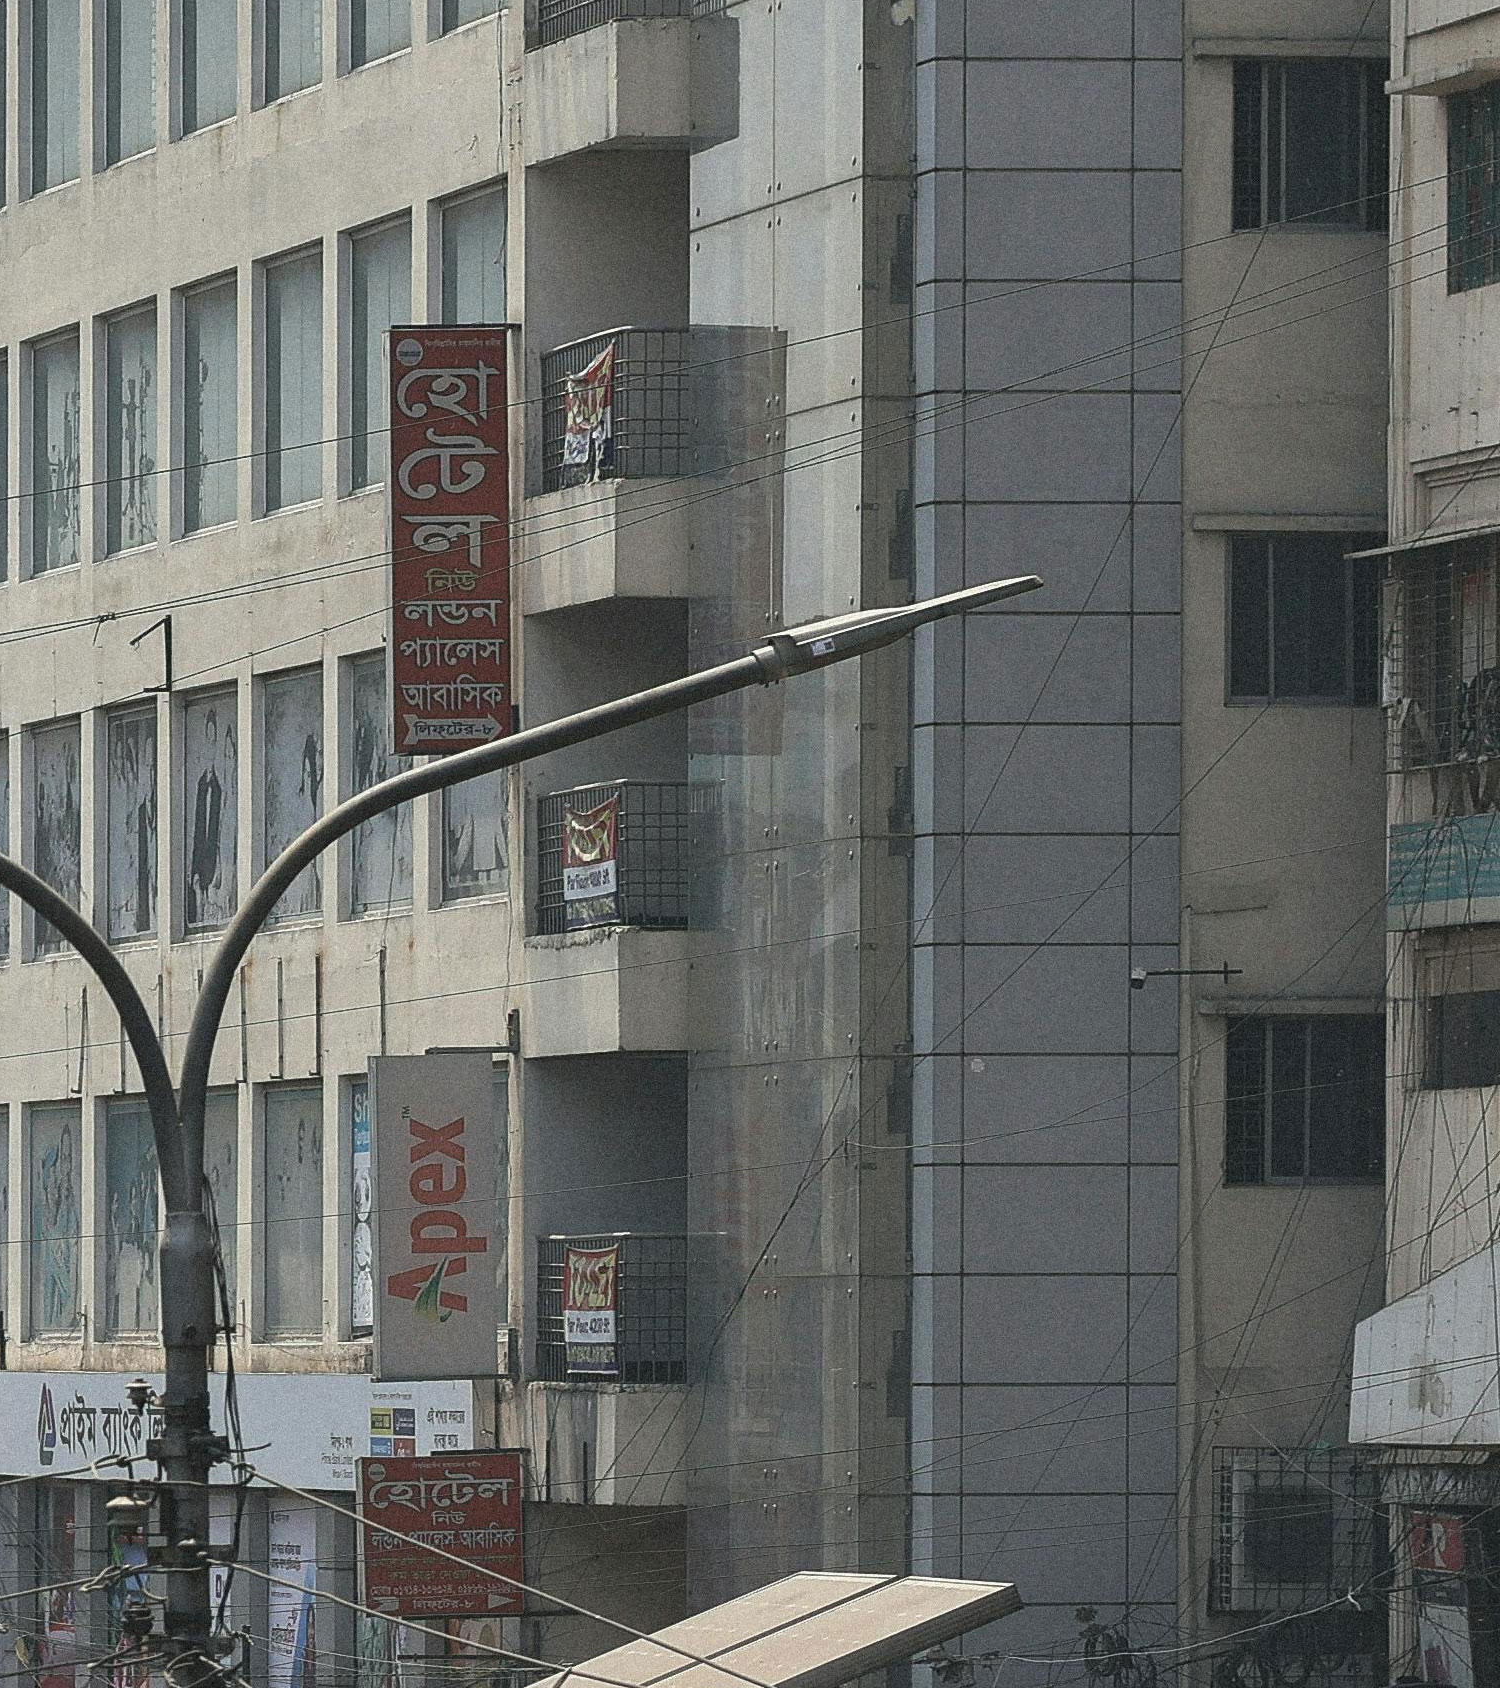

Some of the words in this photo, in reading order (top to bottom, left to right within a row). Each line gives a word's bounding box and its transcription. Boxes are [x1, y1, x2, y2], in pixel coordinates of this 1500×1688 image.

[397, 360, 501, 568] হোটেল
[424, 568, 480, 594] নিউ
[404, 600, 504, 628] লন্ডন
[400, 638, 505, 668] প্যালেস
[400, 673, 505, 712] আবাসিক
[388, 1116, 488, 1318] Apex
[60, 1389, 97, 1459] প্রাইম
[101, 1402, 142, 1457] ব্যাংক
[369, 1470, 515, 1512] হোটেল
[431, 1510, 468, 1526] নিউ
[459, 1521, 516, 1549] আবাসিক
